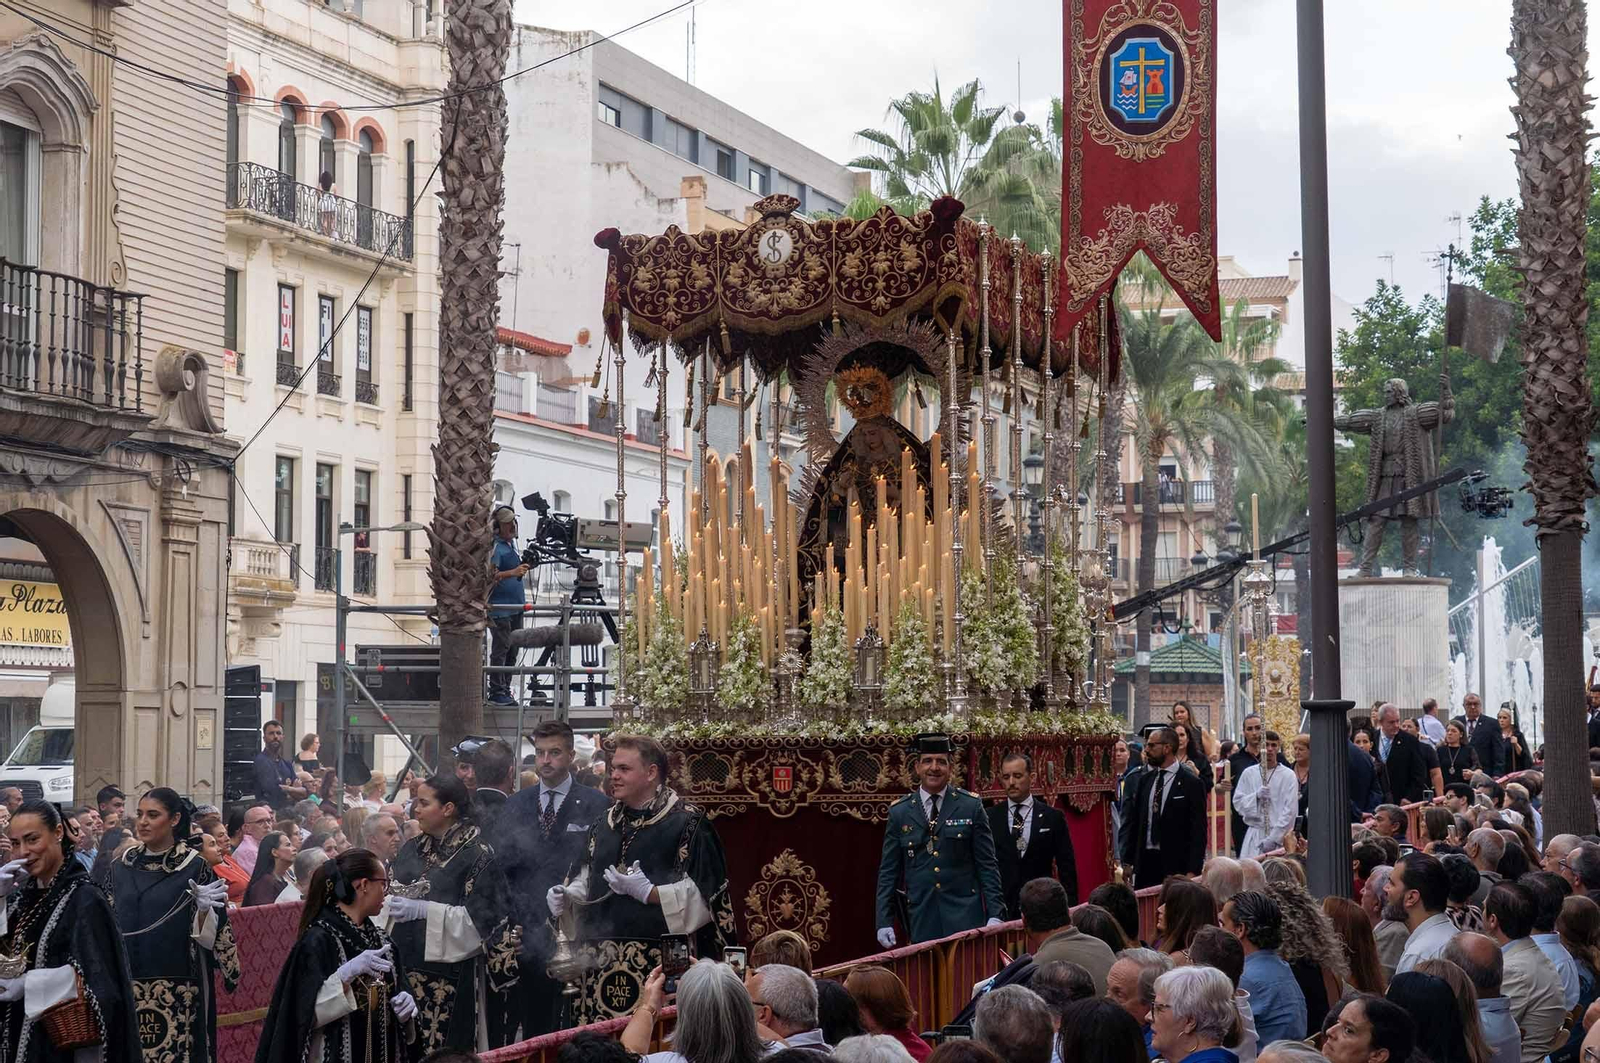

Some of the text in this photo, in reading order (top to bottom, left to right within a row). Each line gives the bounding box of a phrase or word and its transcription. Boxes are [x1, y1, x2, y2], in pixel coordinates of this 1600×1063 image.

[8, 583, 68, 614] Plaza
[22, 628, 62, 644] LABORES
[615, 975, 626, 985] IN
[606, 986, 631, 997] PACE
[612, 997, 626, 1007] XTI
[140, 1013, 155, 1023] IN
[139, 1023, 161, 1034] ACE
